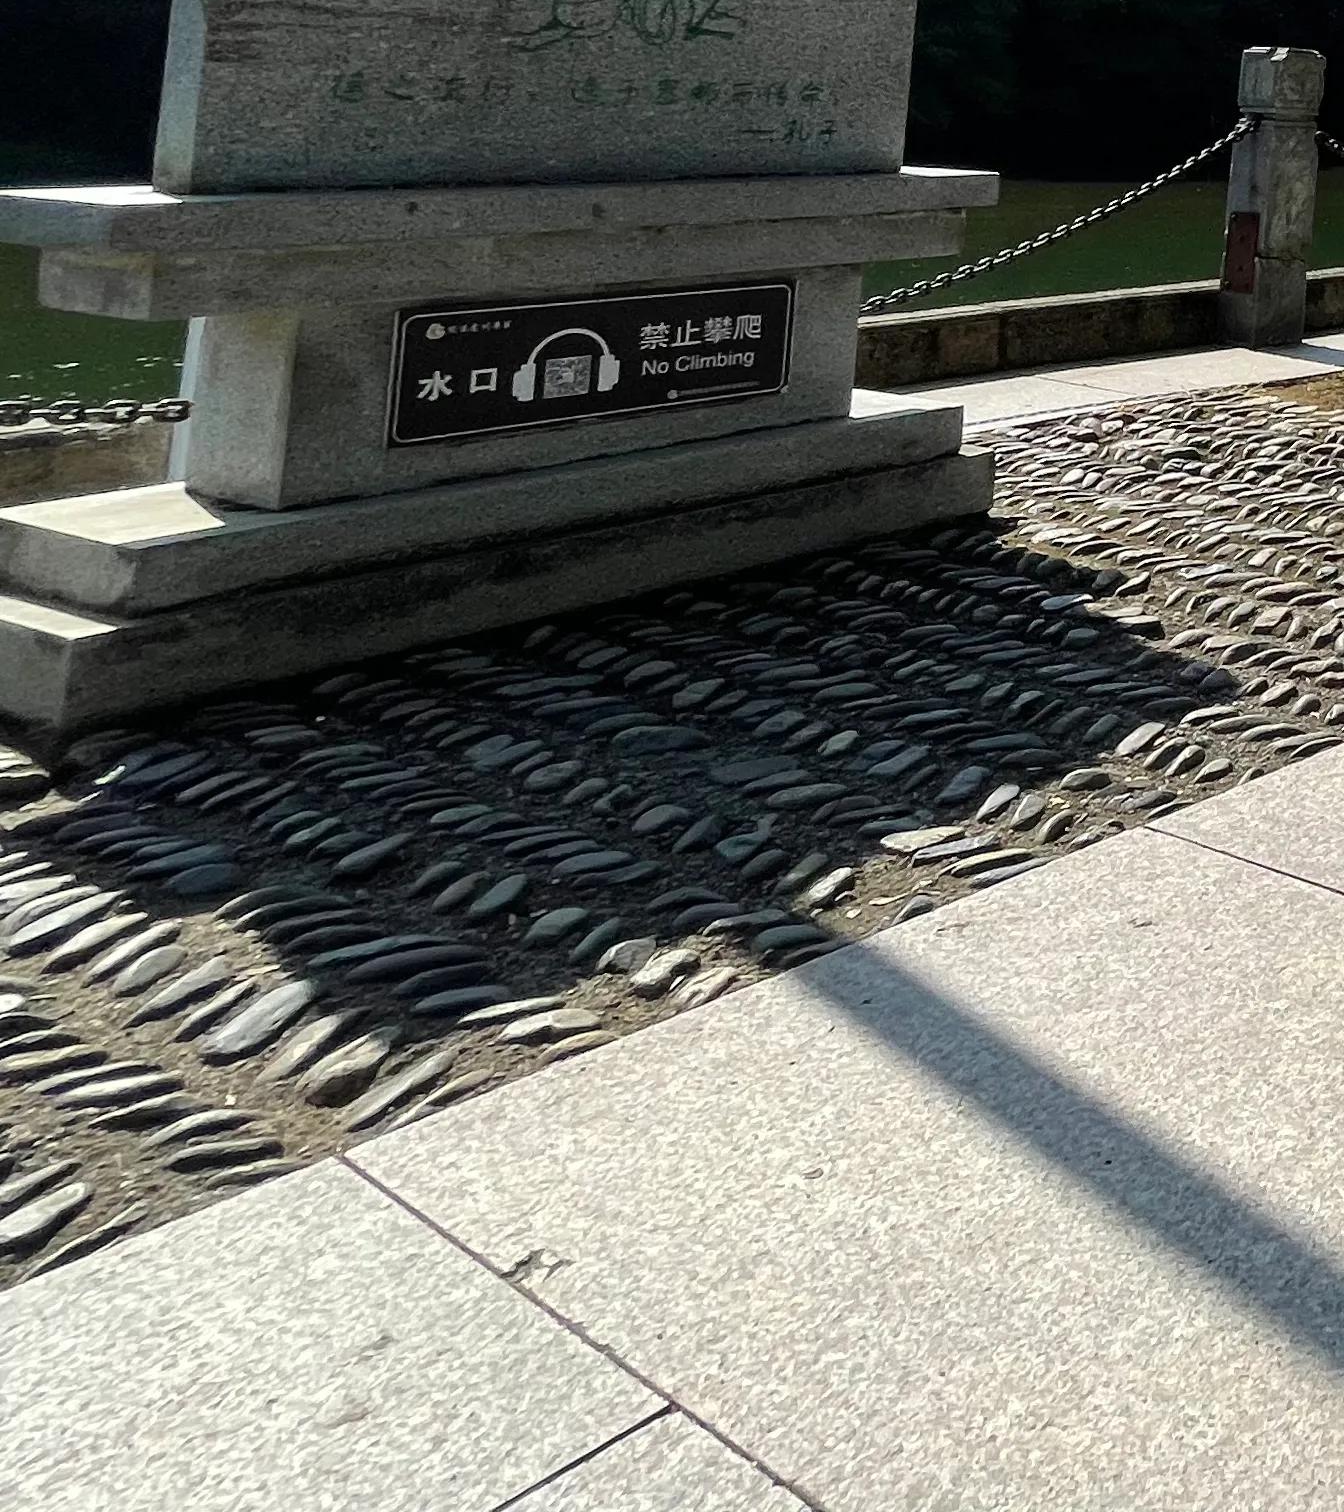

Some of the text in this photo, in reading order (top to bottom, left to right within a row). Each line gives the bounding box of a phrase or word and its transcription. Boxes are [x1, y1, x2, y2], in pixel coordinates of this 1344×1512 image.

[639, 314, 762, 349] 禁止攀爬
[641, 350, 755, 376] No Climbing
[416, 368, 499, 402] 水口
